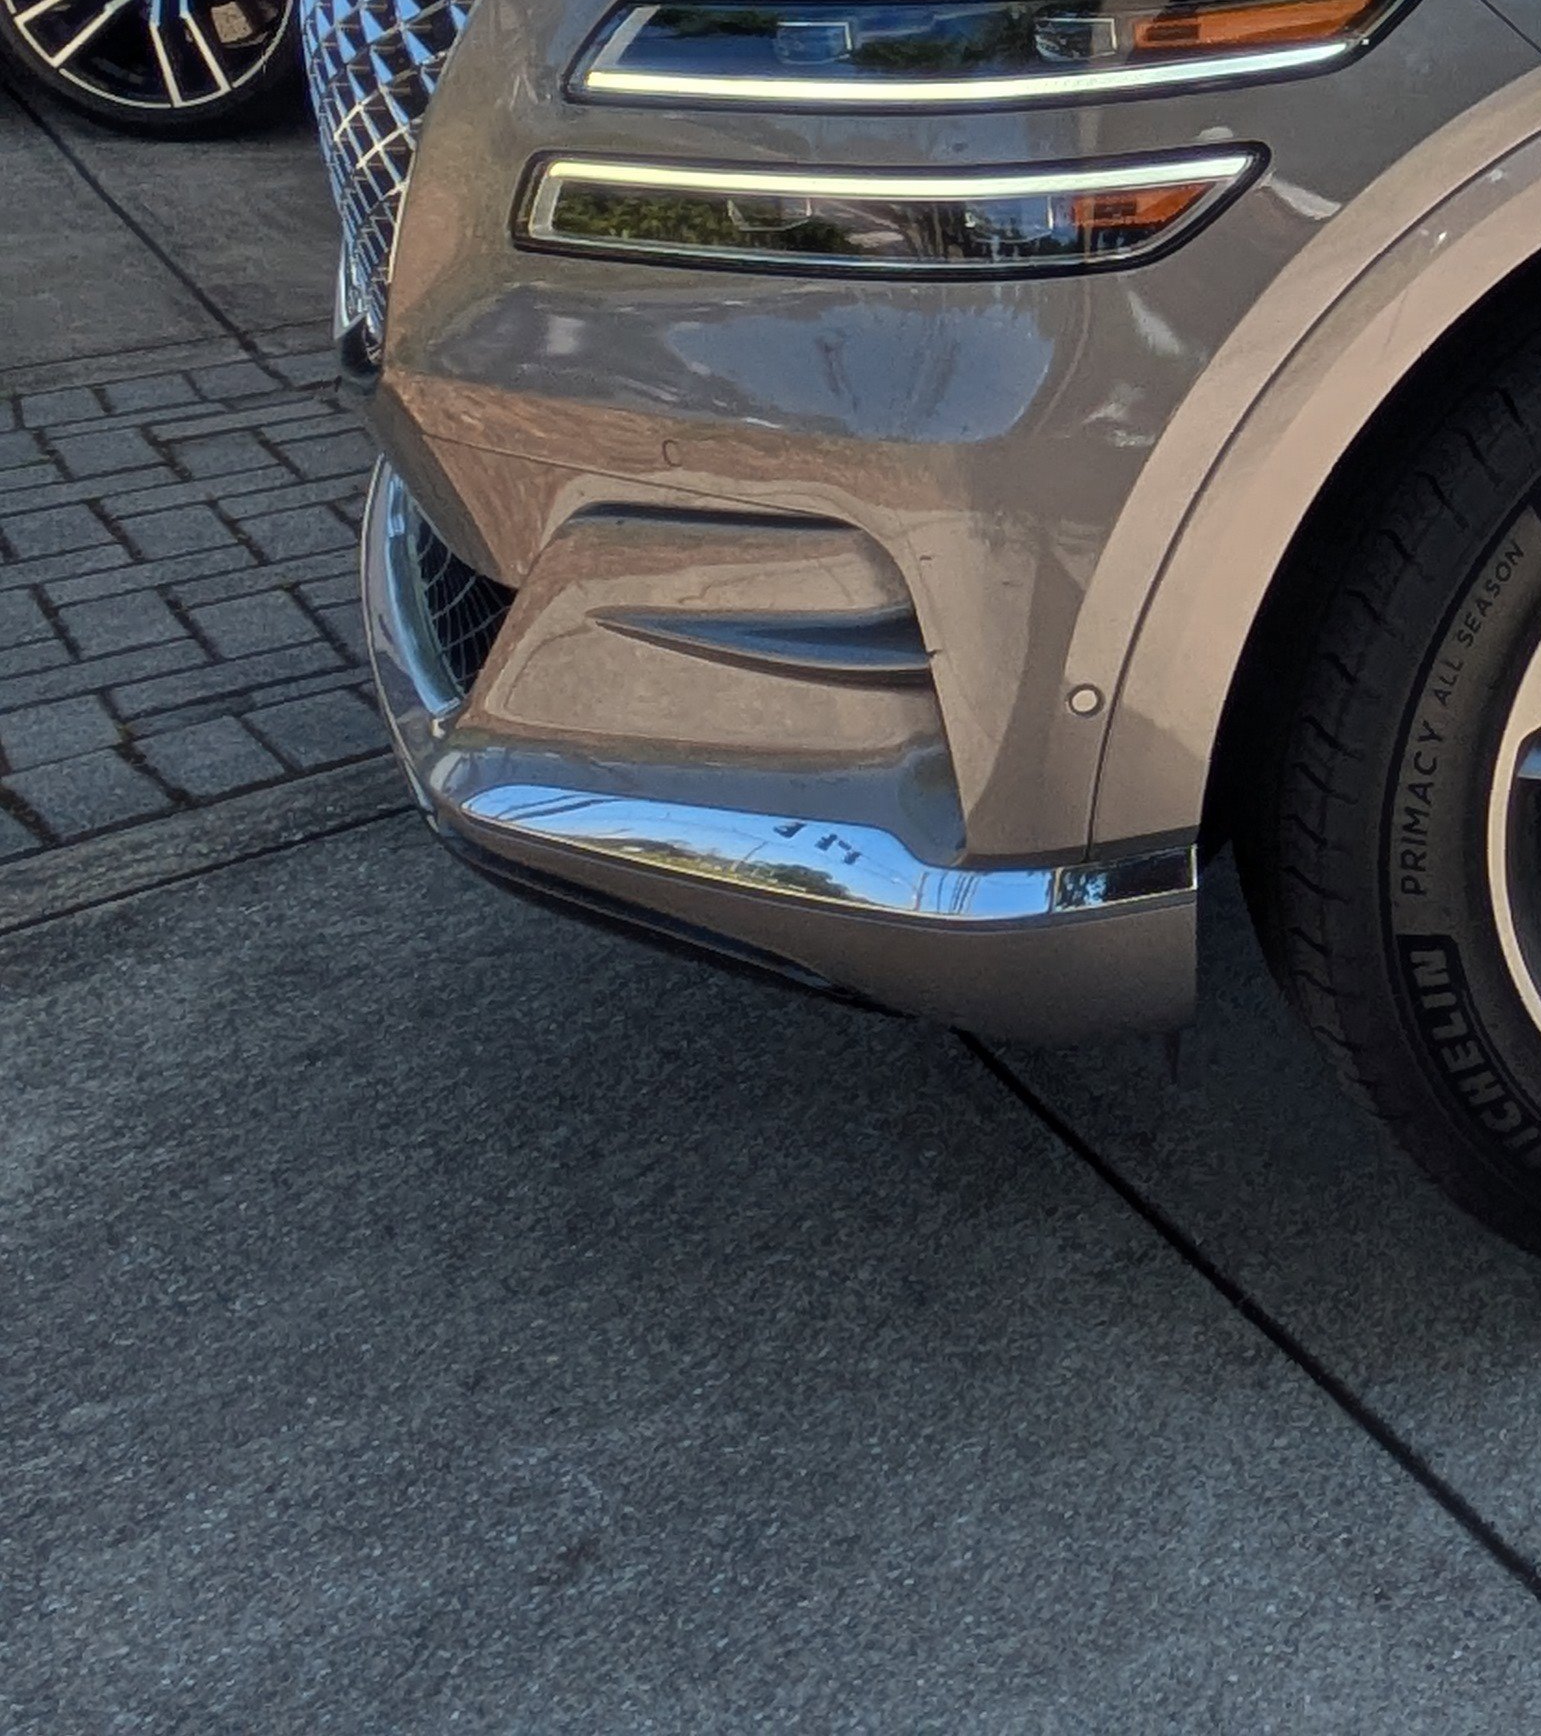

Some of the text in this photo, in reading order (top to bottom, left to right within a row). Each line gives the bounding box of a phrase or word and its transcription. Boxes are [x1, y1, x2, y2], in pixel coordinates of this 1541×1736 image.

[1400, 543, 1526, 897] PRIMACY ALL SEASON
